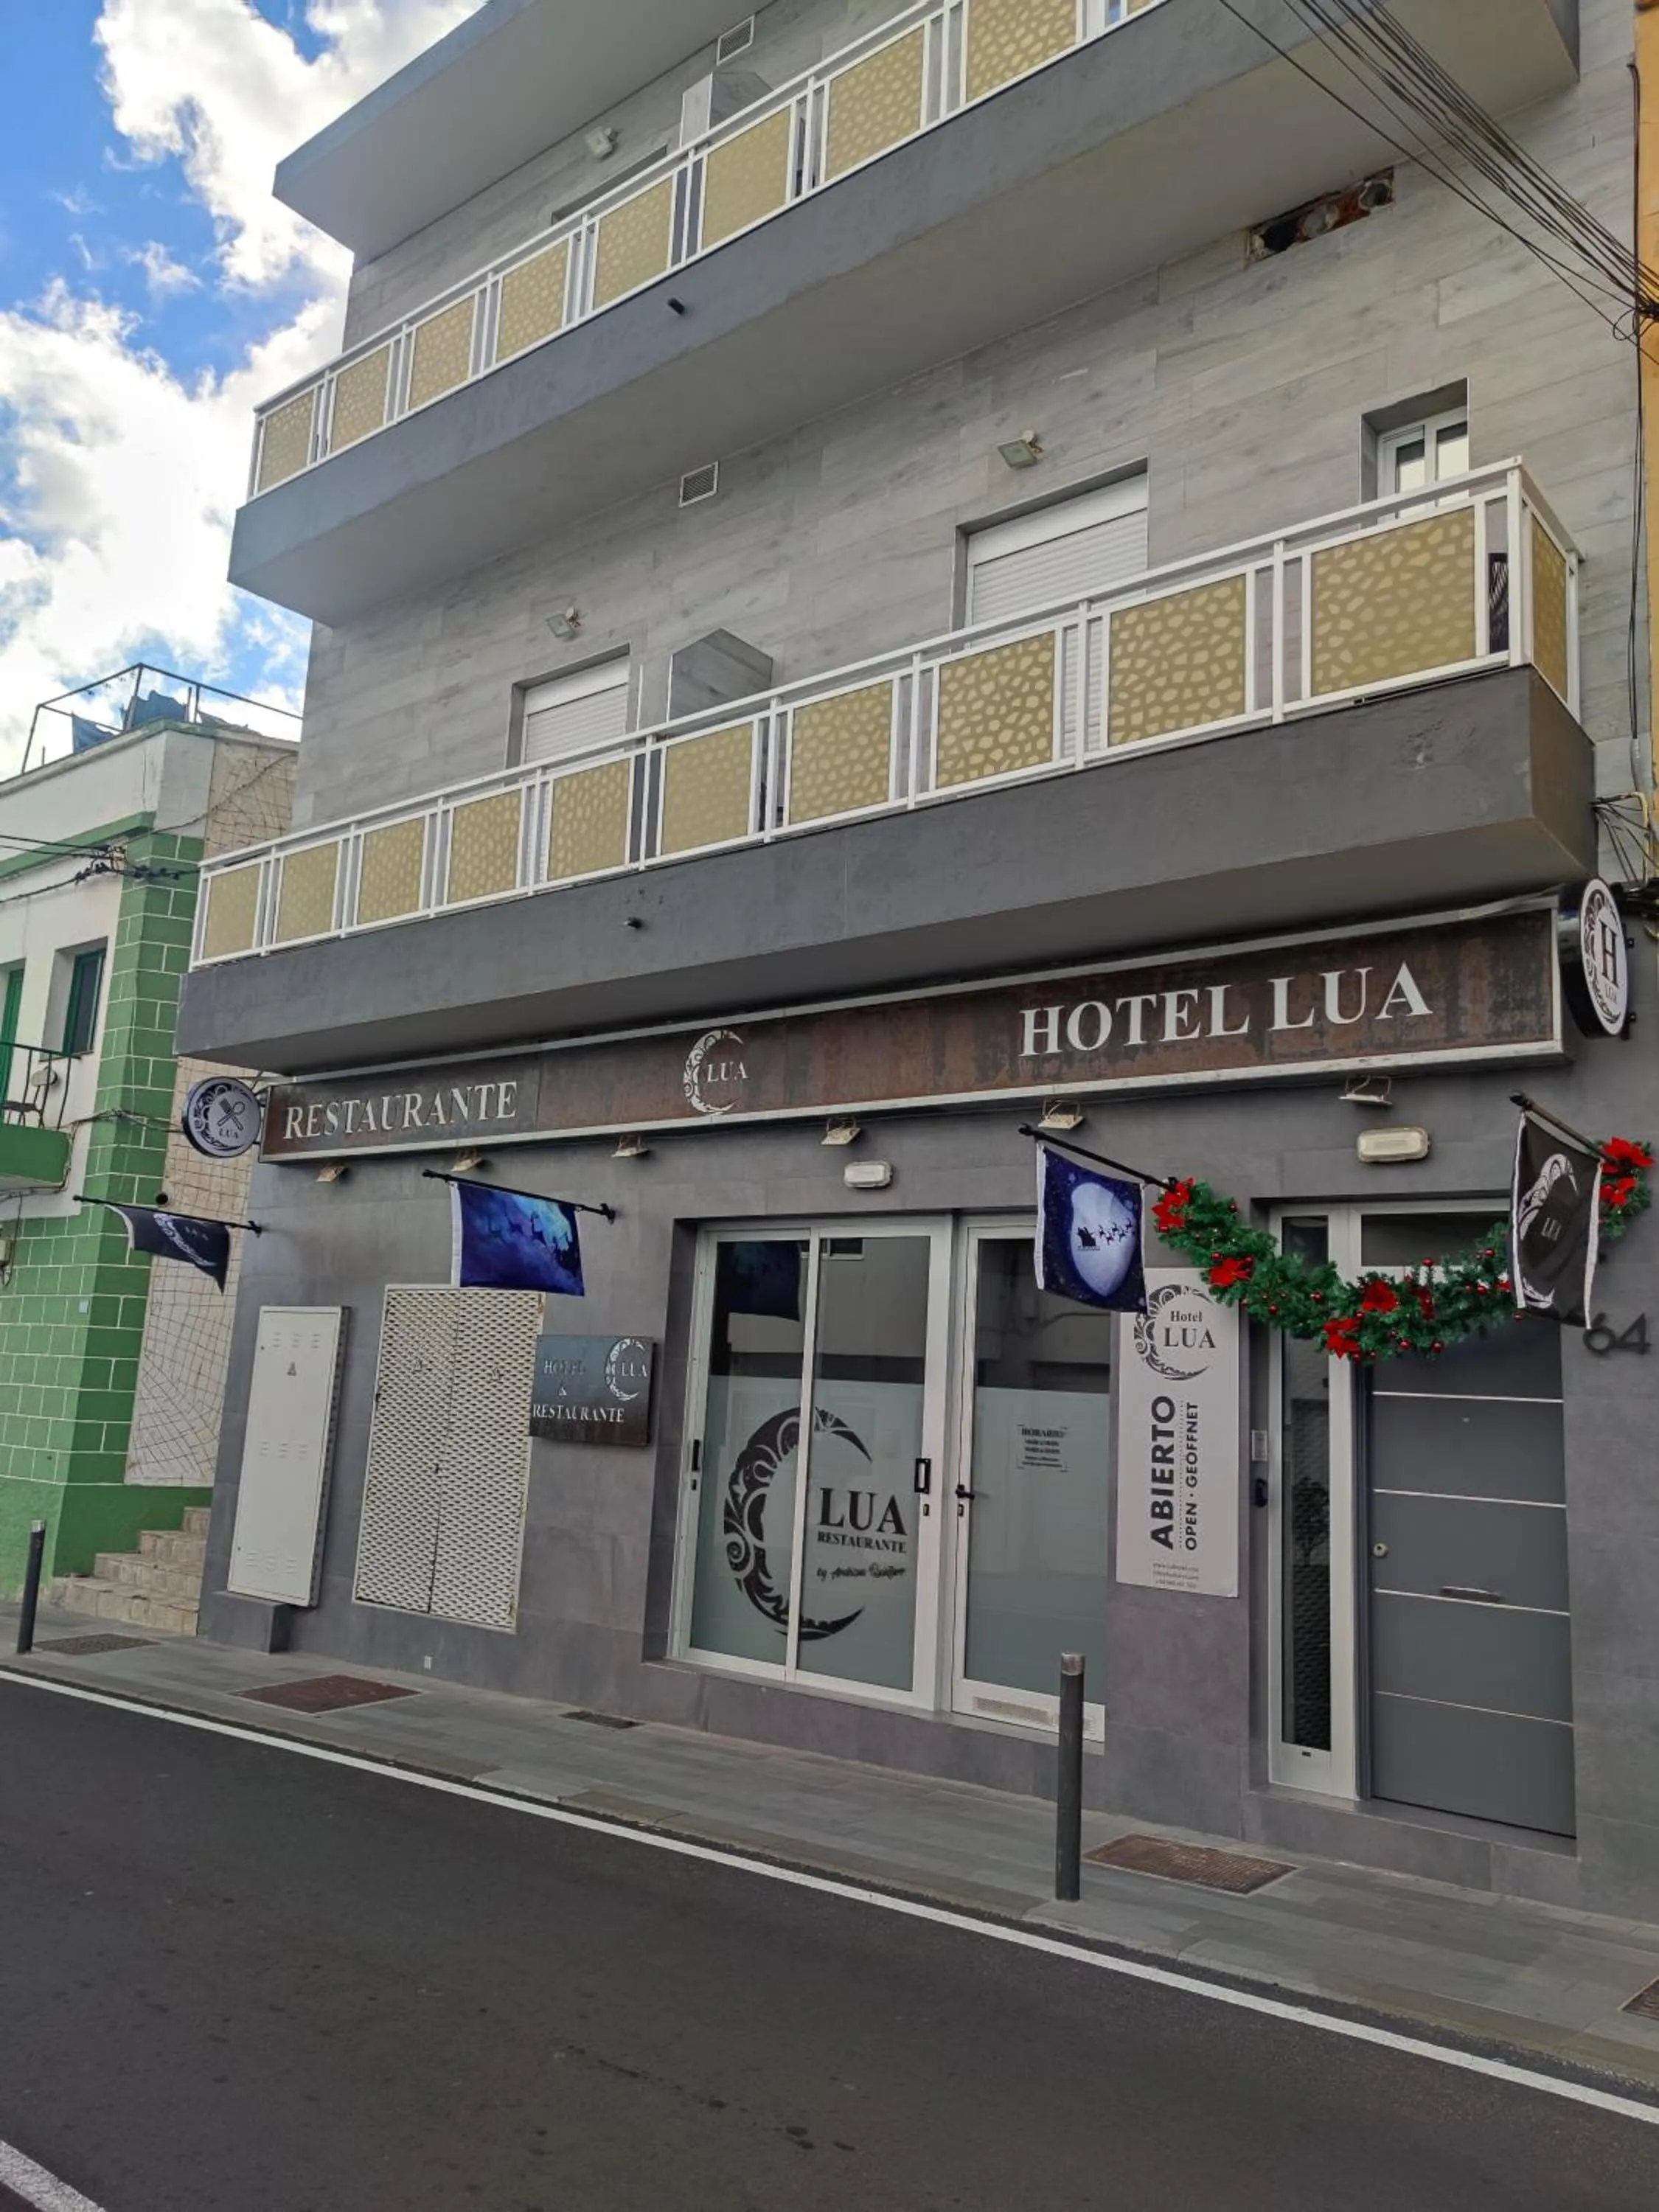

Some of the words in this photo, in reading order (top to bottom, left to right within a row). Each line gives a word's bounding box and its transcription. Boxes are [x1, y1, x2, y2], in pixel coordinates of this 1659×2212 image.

[1018, 984, 1251, 1057] HOTEL
[1267, 962, 1433, 1032] LUA
[707, 1061, 749, 1083] LUA
[283, 1081, 518, 1140] RESTAURANTE
[1170, 1310, 1203, 1322] Hotel
[1164, 1327, 1217, 1349] LUA
[1583, 1312, 1652, 1355] 64
[543, 1359, 587, 1376] HOTEL
[622, 1363, 648, 1377] LUA
[532, 1403, 626, 1423] RESTAURANTE
[1186, 1402, 1198, 1488] GEOFFNET
[1151, 1396, 1175, 1551] ABIERTO
[819, 1487, 908, 1536] LUA
[1186, 1503, 1197, 1551] OPEN
[817, 1531, 907, 1554] RESTAURANTE
